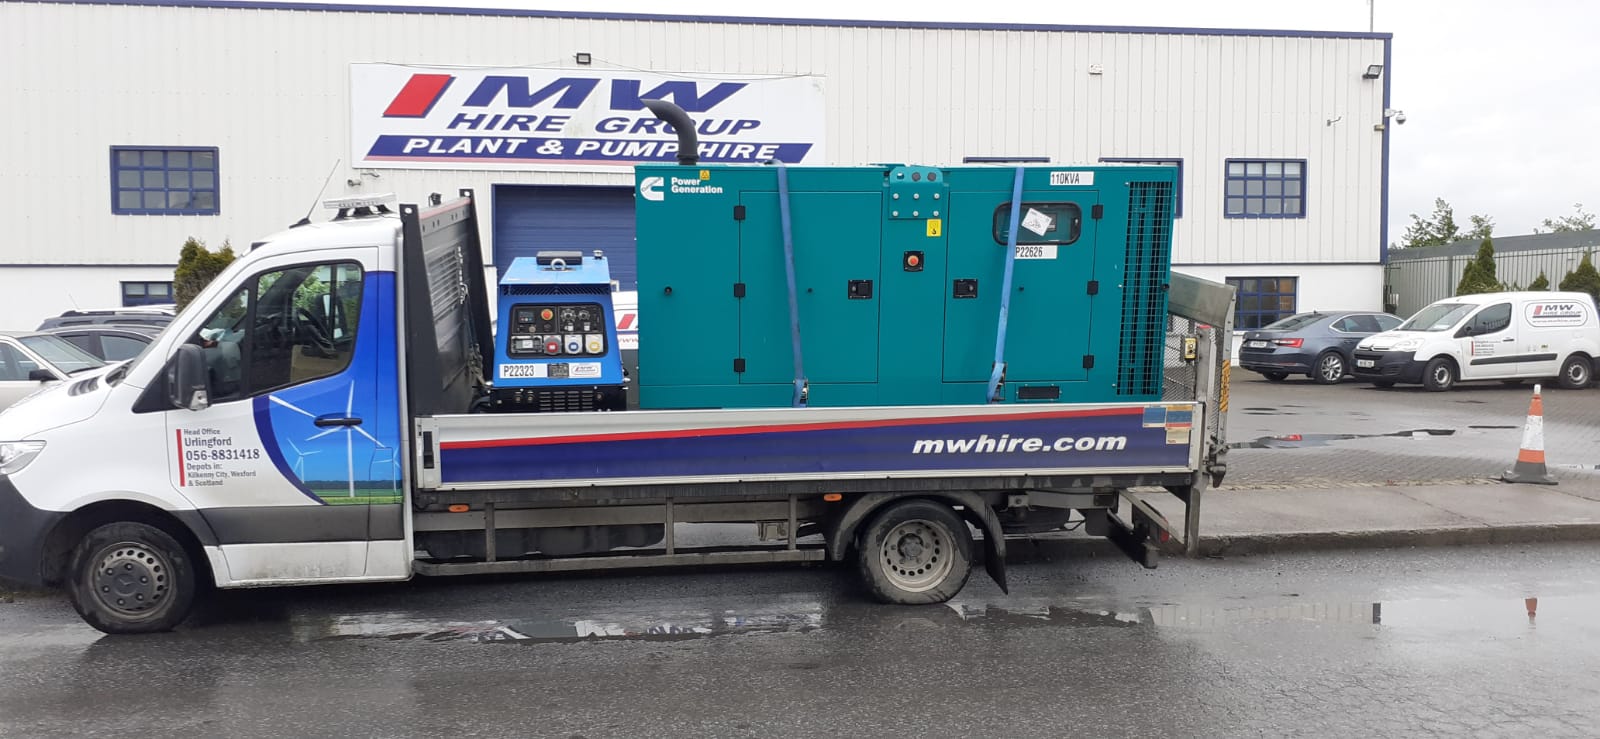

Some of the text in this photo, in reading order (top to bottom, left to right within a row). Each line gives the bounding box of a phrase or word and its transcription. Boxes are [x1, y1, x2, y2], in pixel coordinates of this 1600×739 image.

[462, 75, 749, 113] MW
[446, 113, 571, 133] HIRE
[403, 137, 780, 159] PLANT & PUMP HIRE
[671, 177, 701, 185] Power
[1051, 173, 1080, 184] 110KVA
[671, 185, 723, 194] Generation
[1016, 246, 1043, 258] P22626
[504, 365, 534, 377] P22323
[185, 437, 232, 448] Urlingford
[912, 434, 1127, 454] mwhire.com
[186, 449, 260, 461] 056-8831418
[187, 463, 212, 471] Depots
